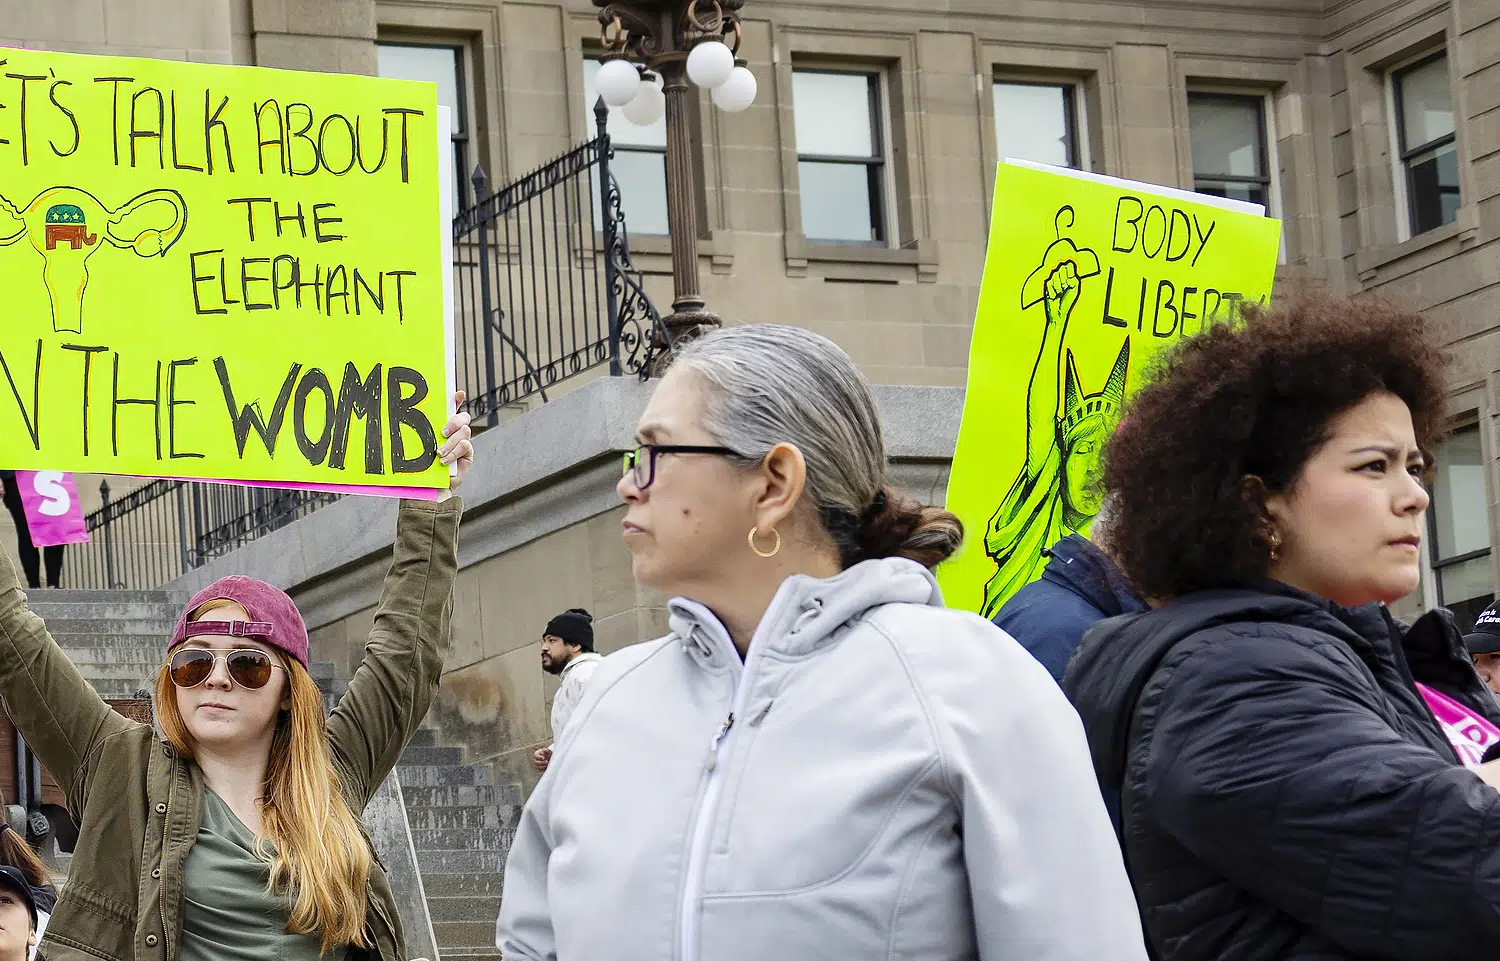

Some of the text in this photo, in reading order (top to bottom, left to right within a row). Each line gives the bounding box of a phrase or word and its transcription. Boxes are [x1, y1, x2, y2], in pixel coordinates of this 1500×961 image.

[94, 76, 235, 176] TALK
[253, 98, 423, 184] ABOUT
[227, 197, 348, 243] THE
[1111, 195, 1215, 268] BODY
[189, 249, 417, 325] ELEPHANT
[1101, 265, 1266, 339] LIBERT
[61, 343, 205, 461] THE
[213, 355, 438, 476] WOMB
